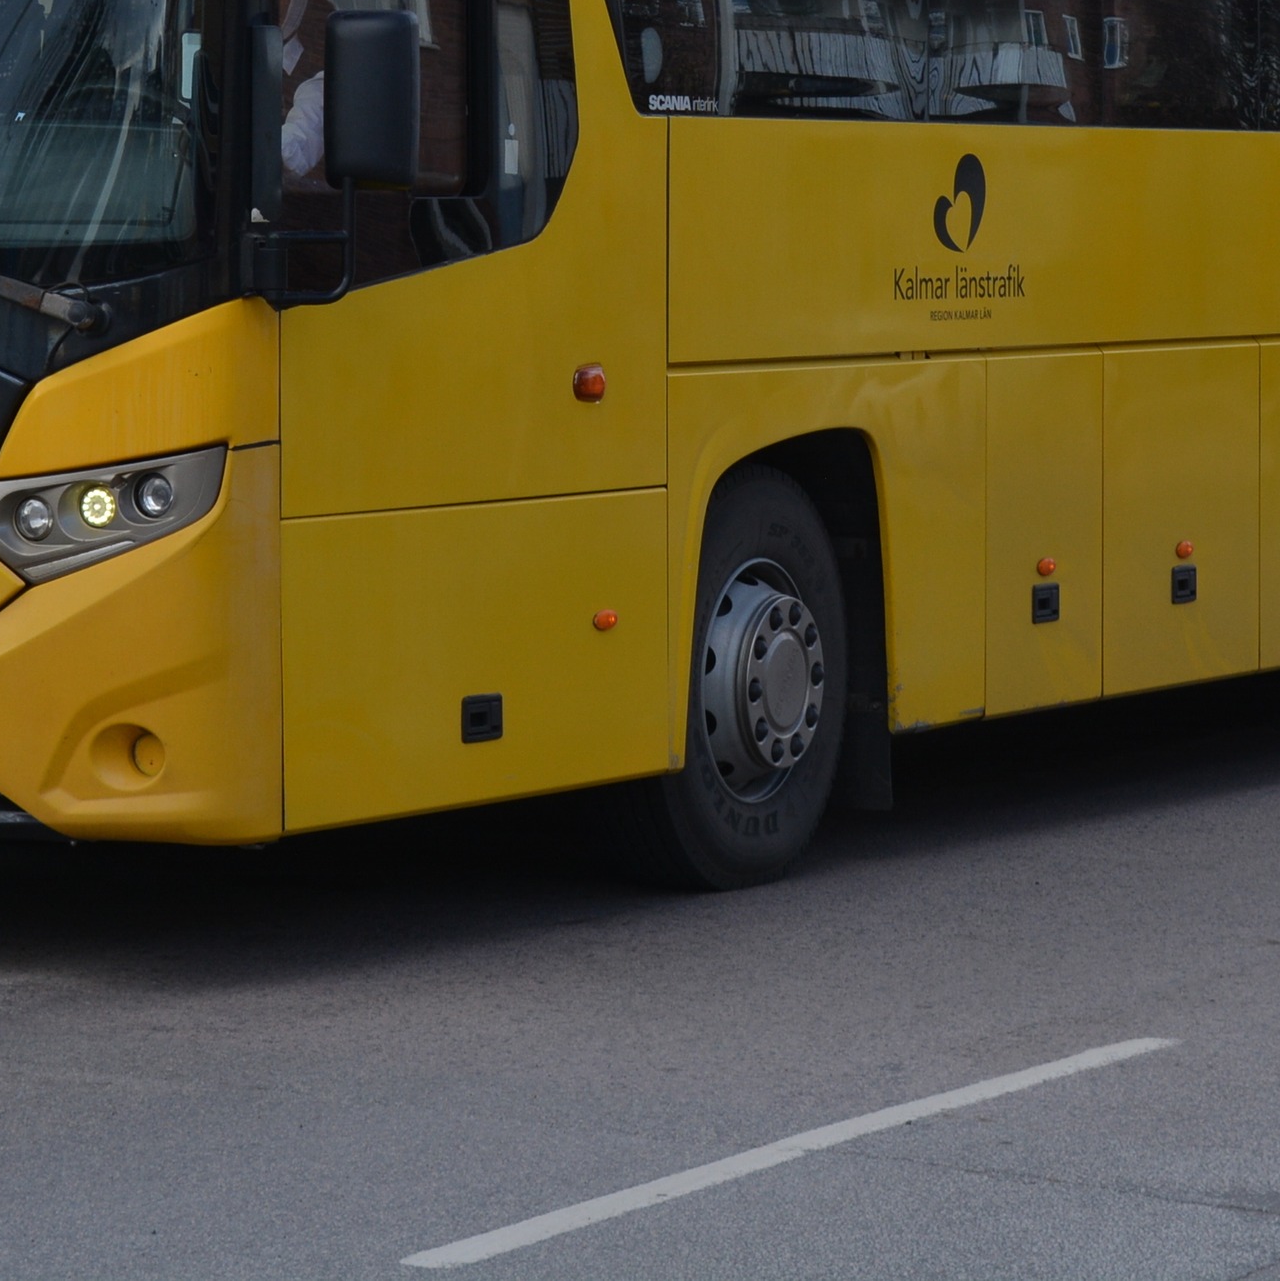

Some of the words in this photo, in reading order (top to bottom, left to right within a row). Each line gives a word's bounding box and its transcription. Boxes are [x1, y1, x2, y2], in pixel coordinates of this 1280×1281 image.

[648, 94, 691, 111] SCANIA
[894, 265, 950, 300] Kalmar
[956, 264, 1025, 299] länstrafik
[930, 309, 953, 321] REGION
[954, 309, 979, 320] KALMAR
[980, 307, 992, 320] LÄN
